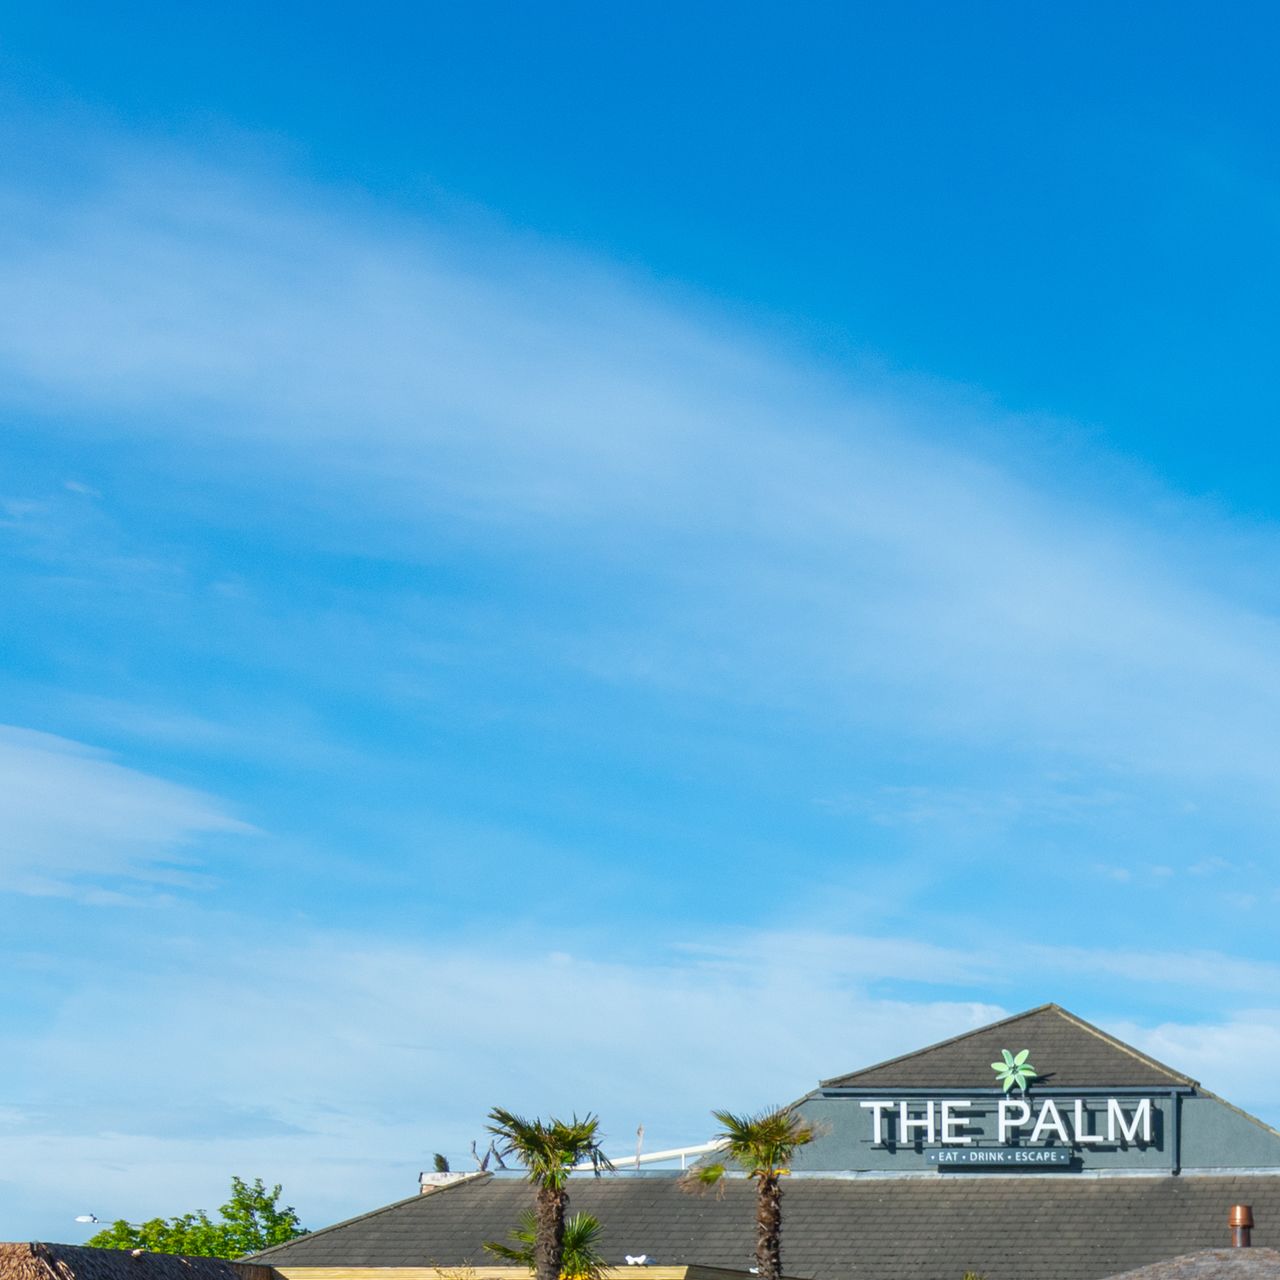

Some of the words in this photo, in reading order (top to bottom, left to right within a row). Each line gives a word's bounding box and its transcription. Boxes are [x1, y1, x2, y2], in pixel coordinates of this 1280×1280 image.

[860, 1100, 972, 1144] THE
[998, 1098, 1152, 1143] PALM
[938, 1151, 958, 1162] EAT
[969, 1151, 1005, 1162] DRINK
[1015, 1151, 1057, 1162] ESCAPE
